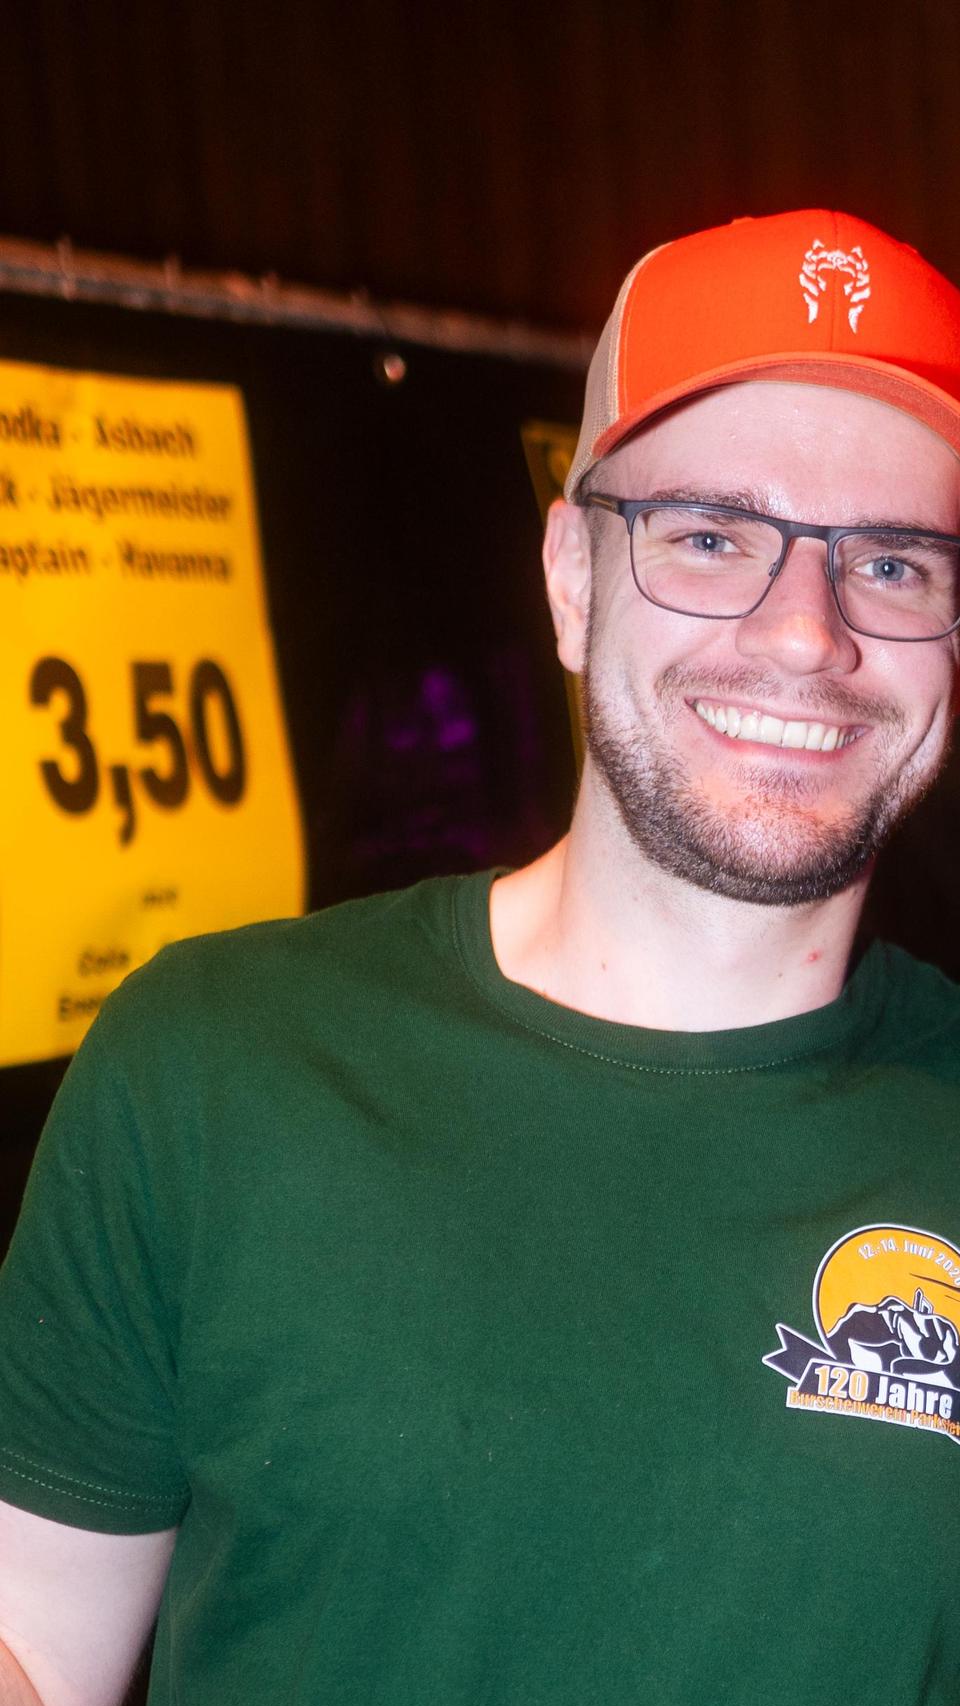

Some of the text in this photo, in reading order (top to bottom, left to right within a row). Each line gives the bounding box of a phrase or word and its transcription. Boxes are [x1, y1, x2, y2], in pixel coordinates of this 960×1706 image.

[93, 415, 197, 459] Asbach
[50, 474, 232, 524] Jägermeister
[29, 655, 248, 850] 3,50
[903, 1239, 934, 1260] Juni
[815, 1365, 953, 1419] 120 Jahre
